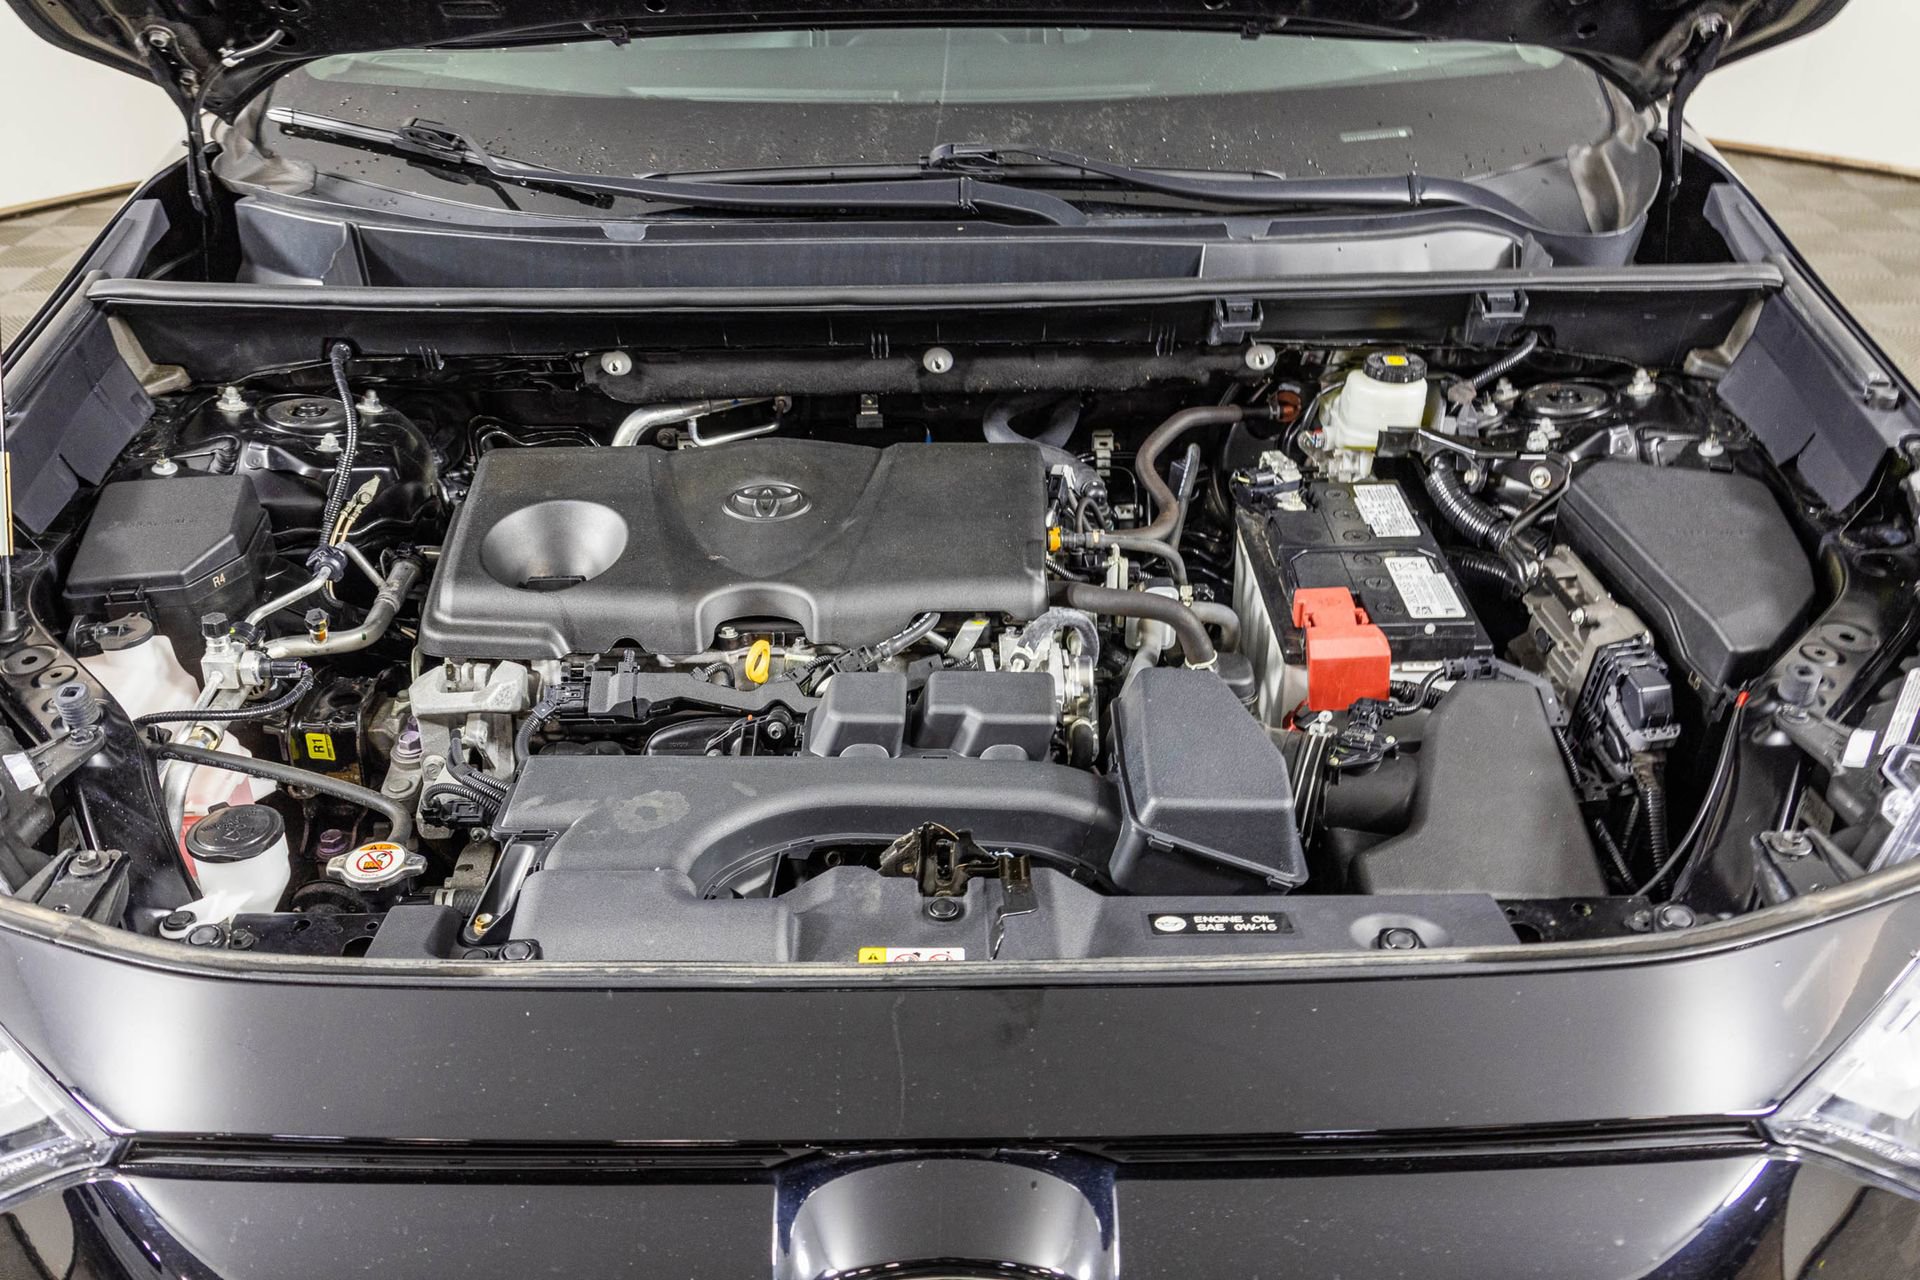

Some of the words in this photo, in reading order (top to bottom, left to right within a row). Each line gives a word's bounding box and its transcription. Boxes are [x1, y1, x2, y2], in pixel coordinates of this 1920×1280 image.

[212, 573, 226, 588] R4
[312, 739, 325, 753] R1
[1193, 915, 1244, 923] ENGINE
[1251, 915, 1275, 923] OIL
[1197, 923, 1226, 931] SAE
